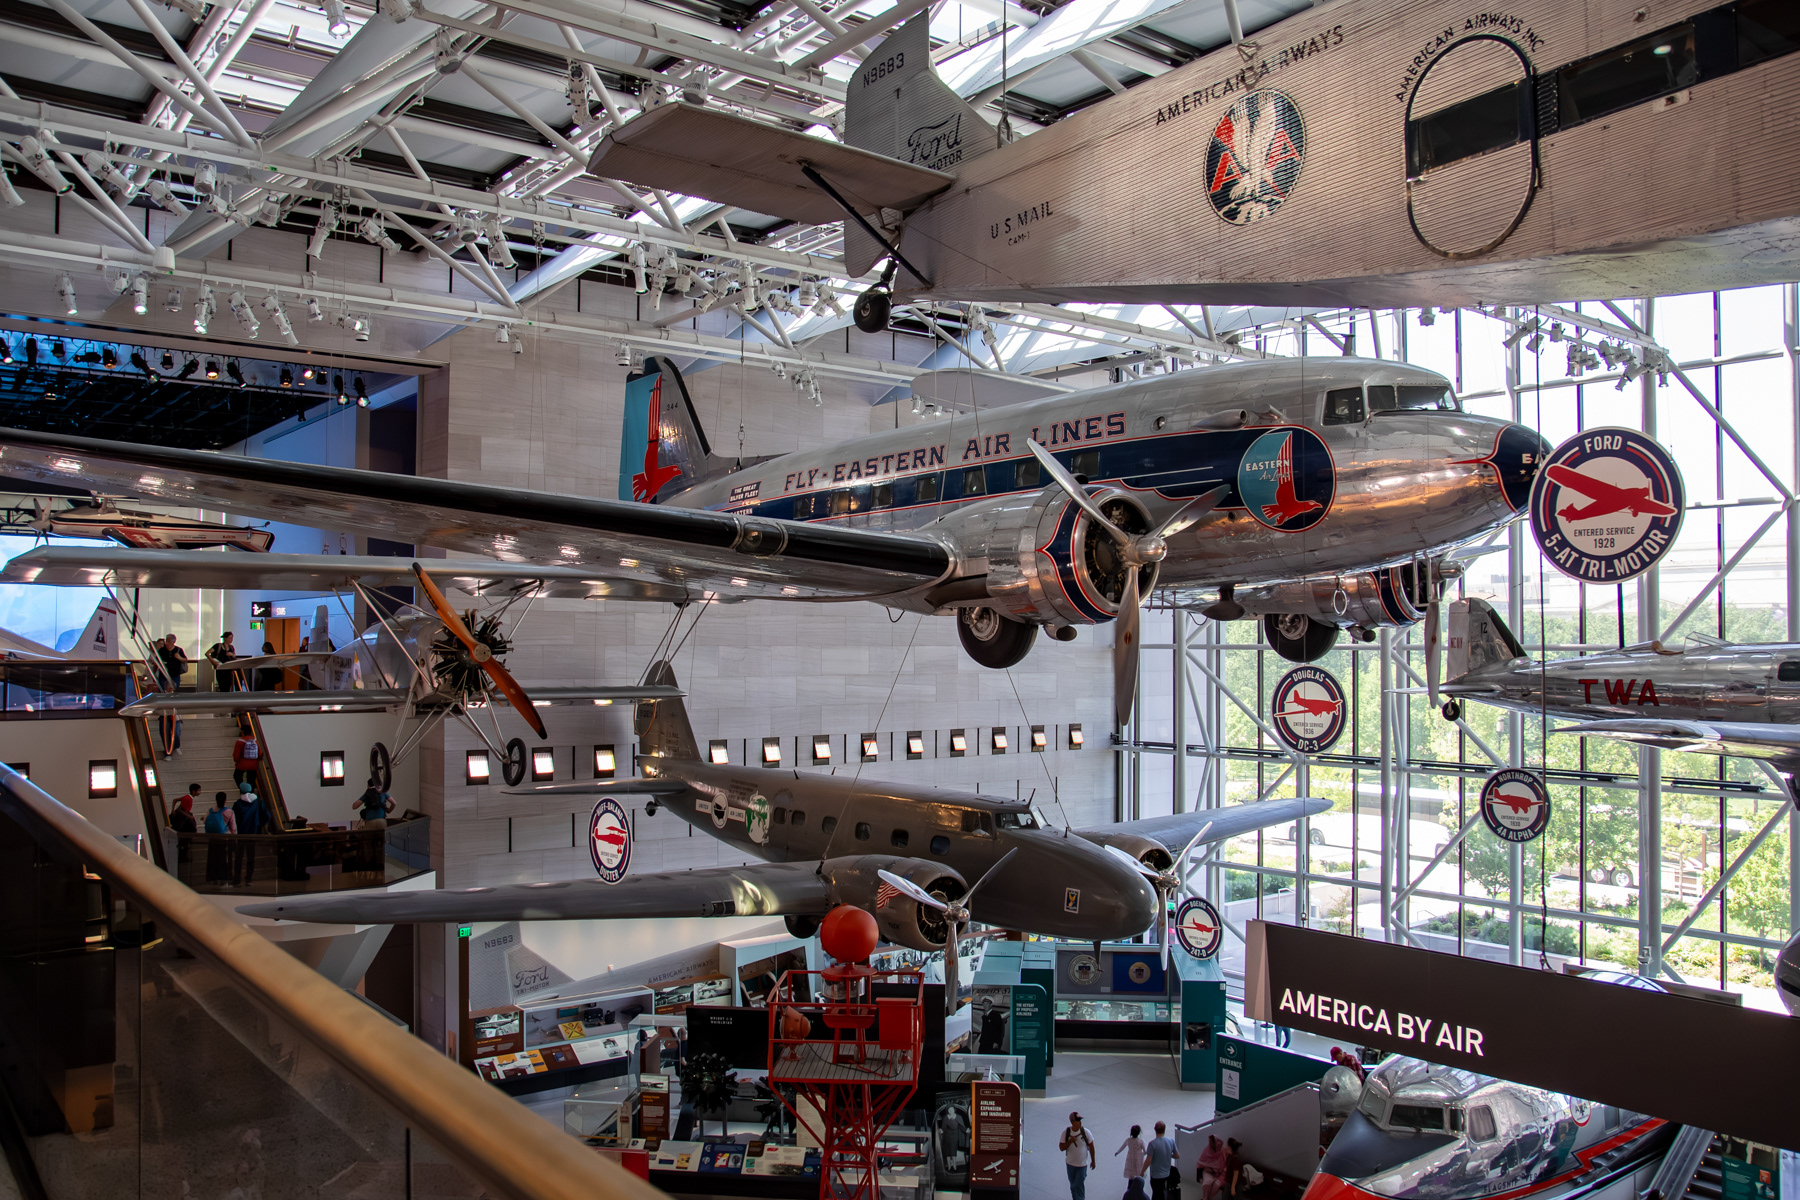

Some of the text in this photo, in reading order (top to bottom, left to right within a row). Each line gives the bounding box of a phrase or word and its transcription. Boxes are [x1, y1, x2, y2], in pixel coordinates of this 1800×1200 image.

[1395, 26, 1454, 103] AMERICAN
[1464, 12, 1524, 34] AIRWAYS
[863, 52, 905, 88] N9683
[1156, 25, 1344, 126] AMERICAN AIRWAYS
[907, 112, 963, 164] Ford
[1017, 200, 1054, 228] MAIL
[666, 402, 679, 412] 344
[962, 432, 1012, 462] AIR
[1031, 410, 1127, 449] LINES
[1584, 435, 1623, 454] FORD
[1245, 458, 1290, 472] EASTERN
[744, 483, 757, 493] GREAT
[730, 490, 759, 502] SILVER FLEET
[1573, 526, 1635, 537] ENTERED SERVICE
[1593, 537, 1616, 549] 1928
[1544, 528, 1670, 579] 5-AT TRI-MOTOR
[1480, 622, 1488, 634] 12
[1292, 669, 1325, 682] DOUGLAS
[1578, 679, 1660, 707] TWA
[1297, 738, 1319, 751] DC-3
[1497, 771, 1534, 784] NORTHROP
[596, 801, 624, 821] HUFF-DALAND
[1496, 826, 1535, 841] 4A ALPHA
[599, 865, 620, 881] DUSTER
[1189, 900, 1207, 909] BOEING
[1190, 947, 1207, 957] 247-D
[513, 965, 550, 989] Ford
[648, 959, 714, 985] AMERICAN AIRWAYS
[516, 981, 550, 995] TRI-MOTOR
[1279, 987, 1485, 1057] AMERICA BY AIR
[1219, 1056, 1243, 1070] ENTRANCE
